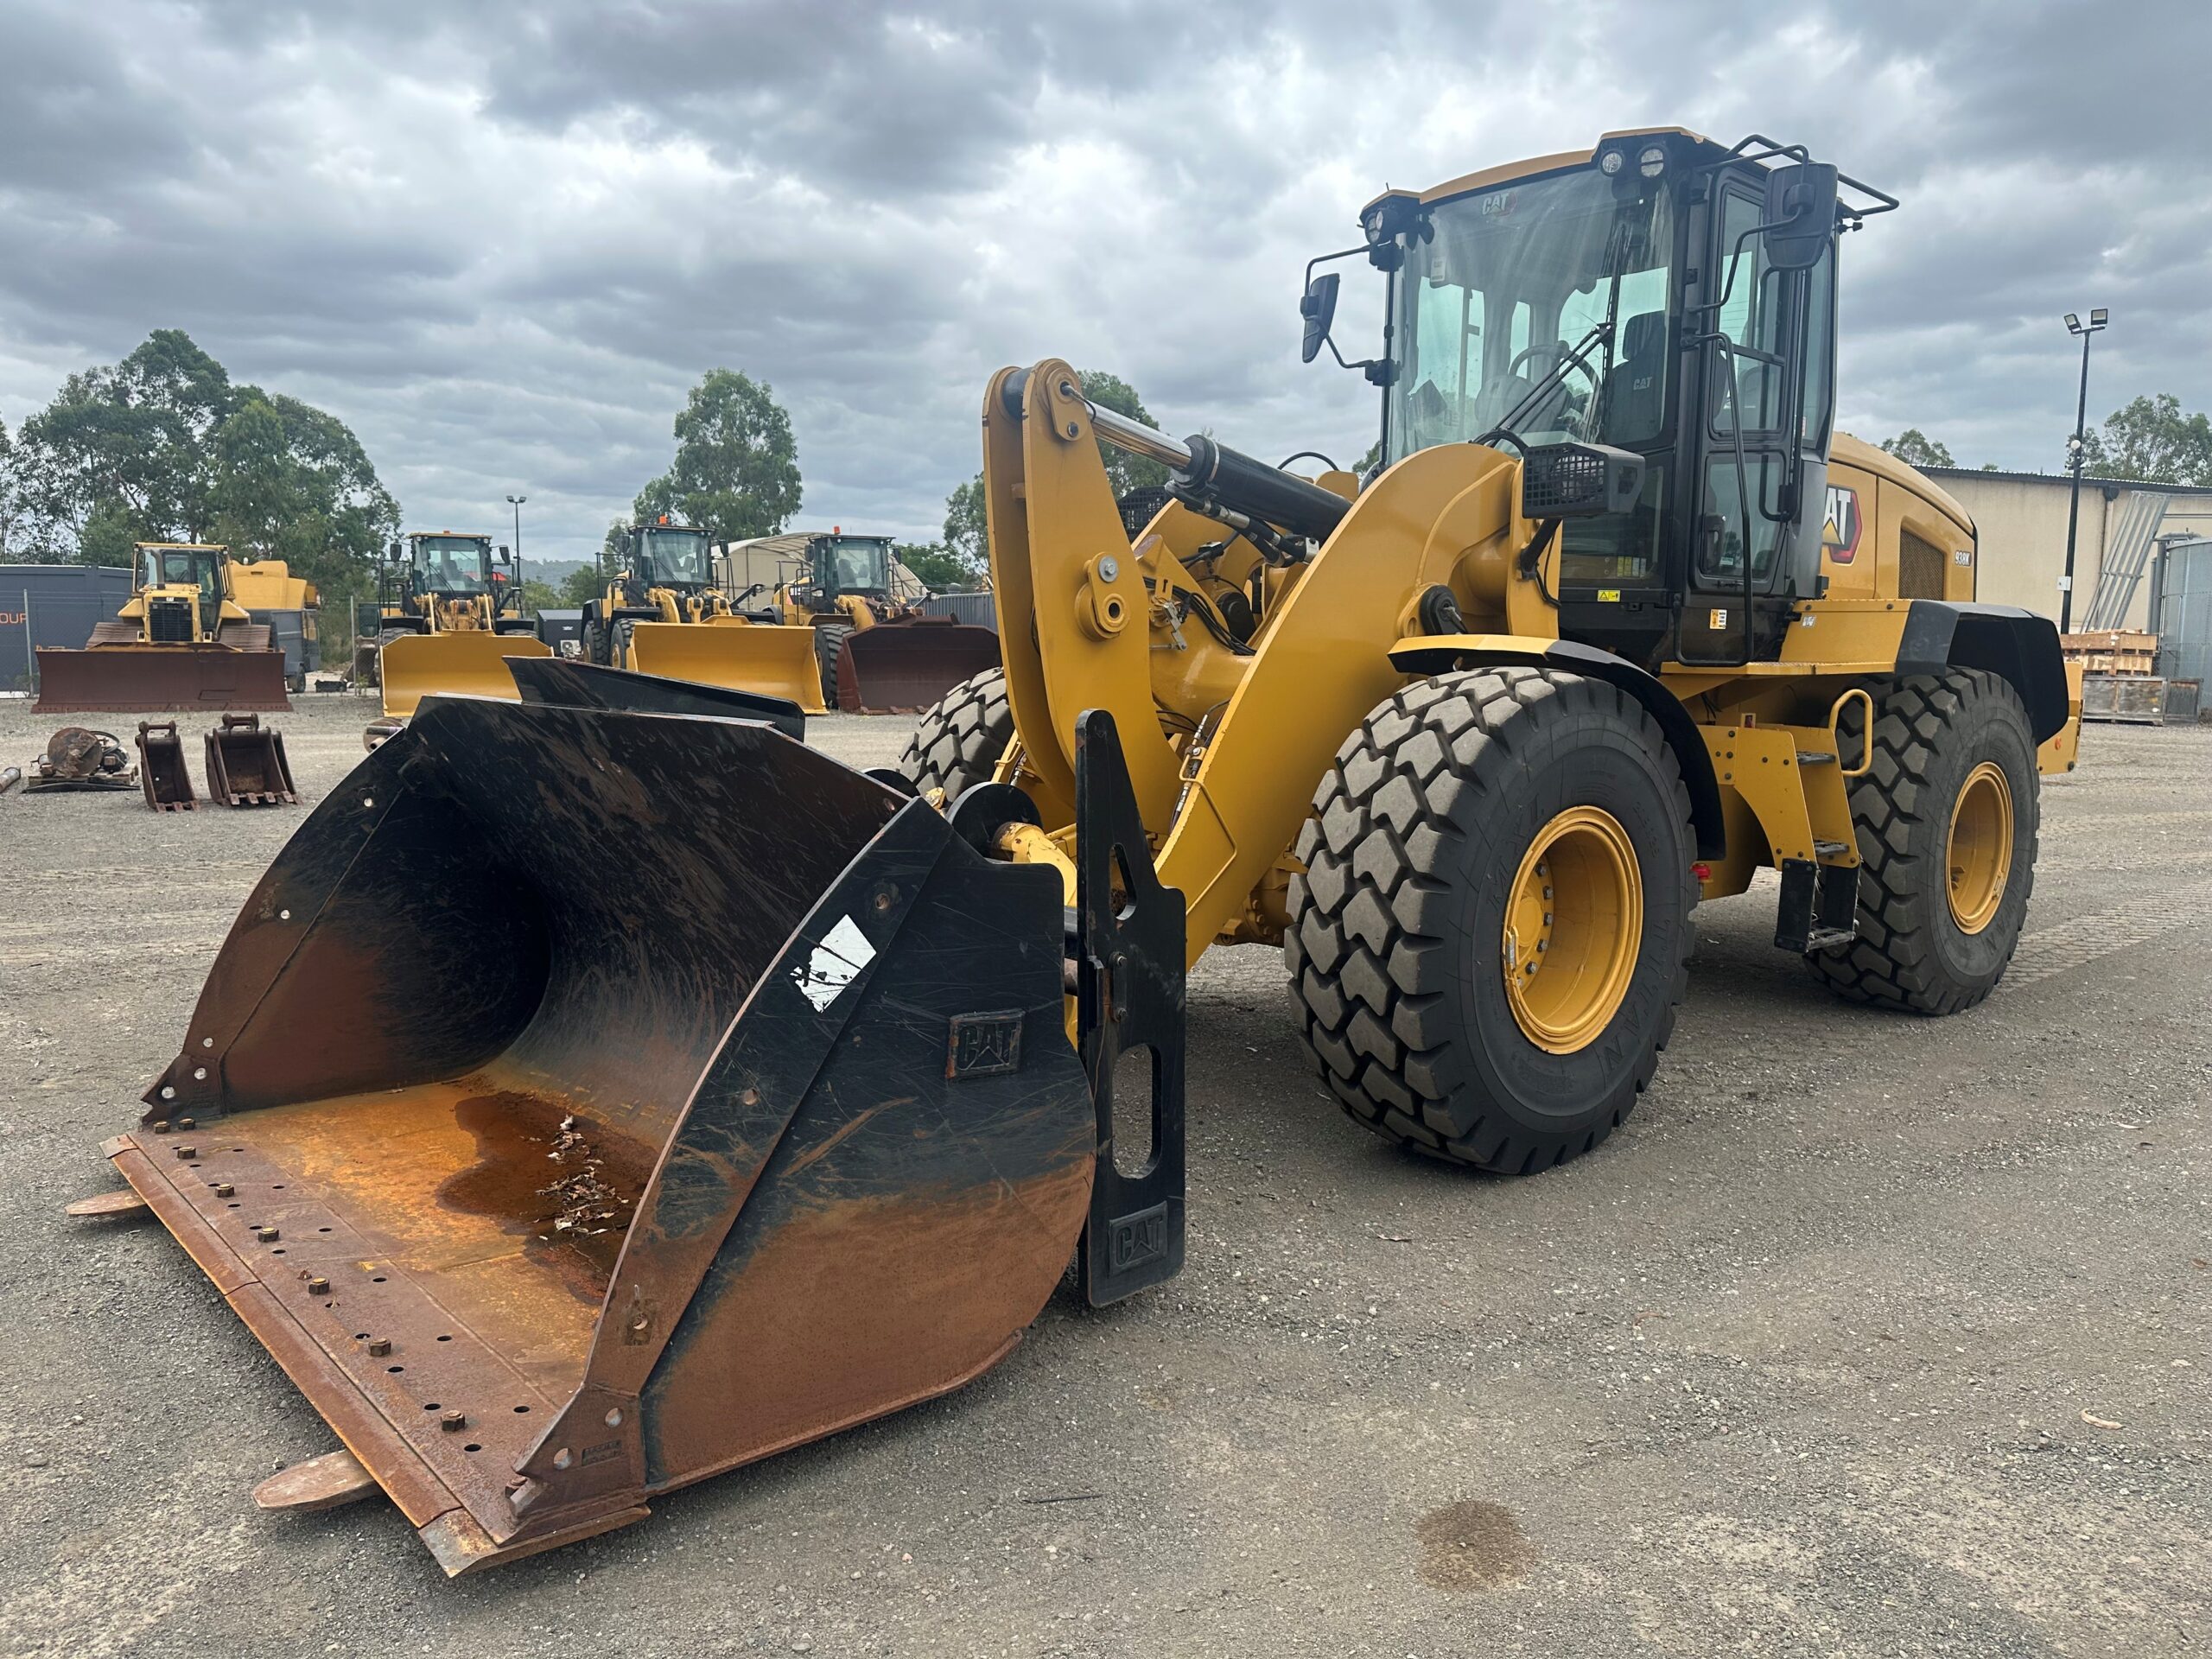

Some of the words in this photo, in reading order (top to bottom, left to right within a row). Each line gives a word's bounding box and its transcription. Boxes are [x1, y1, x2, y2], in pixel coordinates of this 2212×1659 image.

[1482, 193, 1510, 215] CAT
[1633, 376, 1653, 390] CAT
[1823, 487, 1852, 545] AT
[1955, 550, 1971, 566] 938K
[1605, 918, 1671, 1073] TITAN
[956, 1022, 1018, 1071] CAT
[1116, 1214, 1164, 1266] CAT
